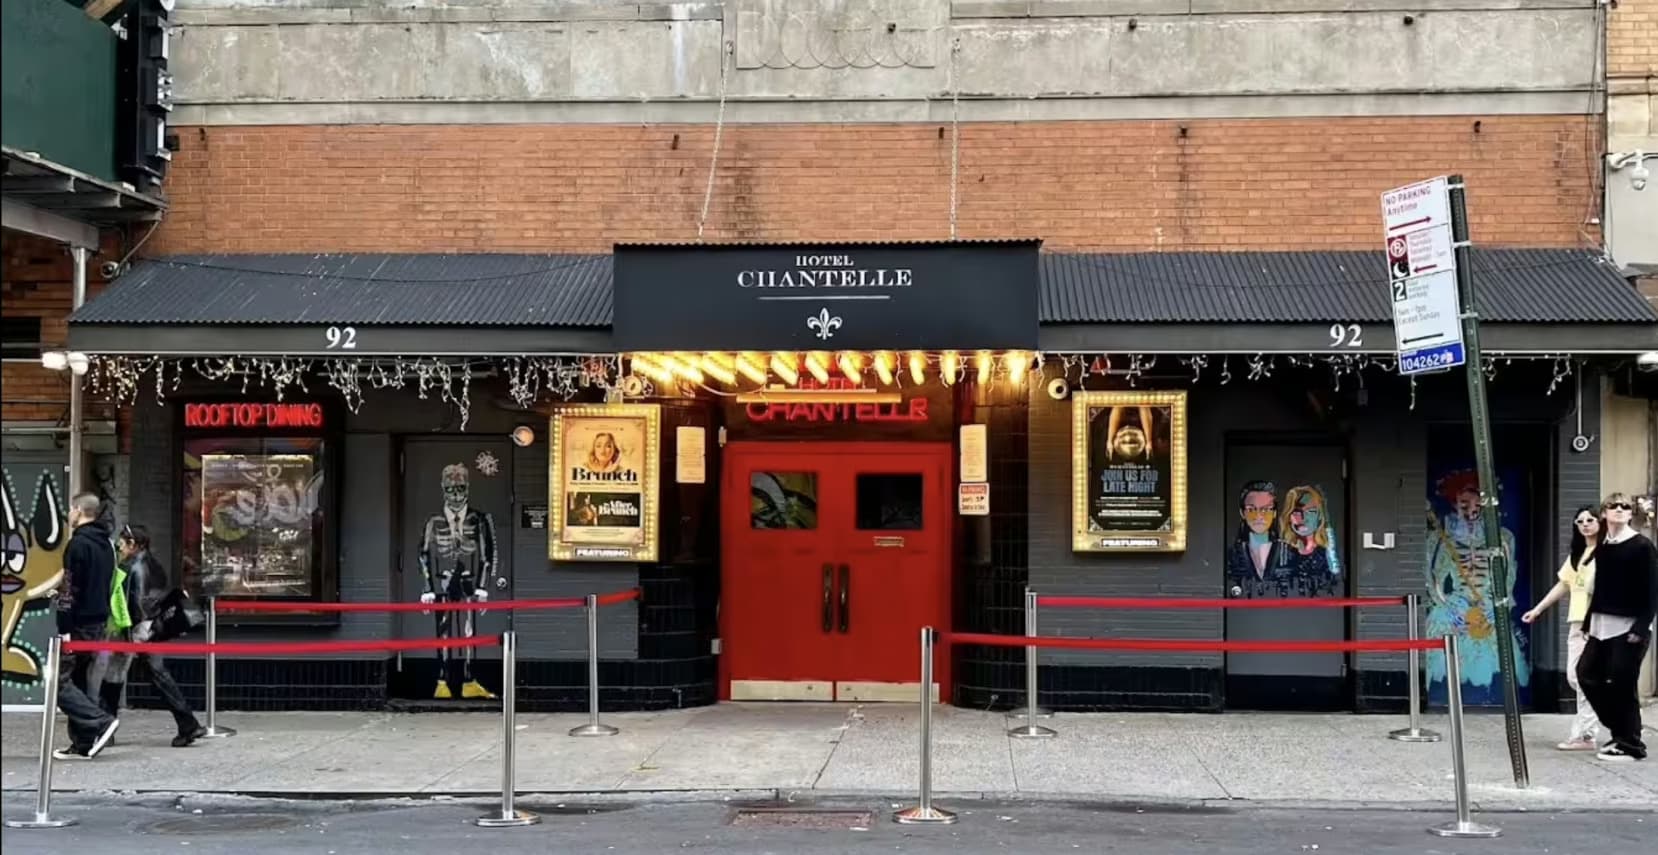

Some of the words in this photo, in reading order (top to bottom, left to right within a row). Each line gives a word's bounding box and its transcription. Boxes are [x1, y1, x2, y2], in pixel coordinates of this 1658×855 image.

[1386, 196, 1397, 205] NO
[1399, 186, 1431, 202] PARKING
[1388, 203, 1418, 216] Anytime
[796, 255, 854, 267] HOTEL
[737, 269, 912, 288] CHANTELLE
[1394, 282, 1405, 301] 2
[326, 326, 357, 349] 92
[1329, 323, 1362, 347] 92
[1402, 353, 1440, 371] 104262
[185, 404, 263, 427] ROOFTOP
[266, 404, 322, 427] DINING
[572, 467, 637, 482] Brunch
[1101, 470, 1122, 481] JOIN
[1125, 470, 1137, 481] US
[1140, 470, 1158, 481] FOR
[1103, 482, 1126, 493] LATE
[1128, 482, 1155, 493] NIGHT
